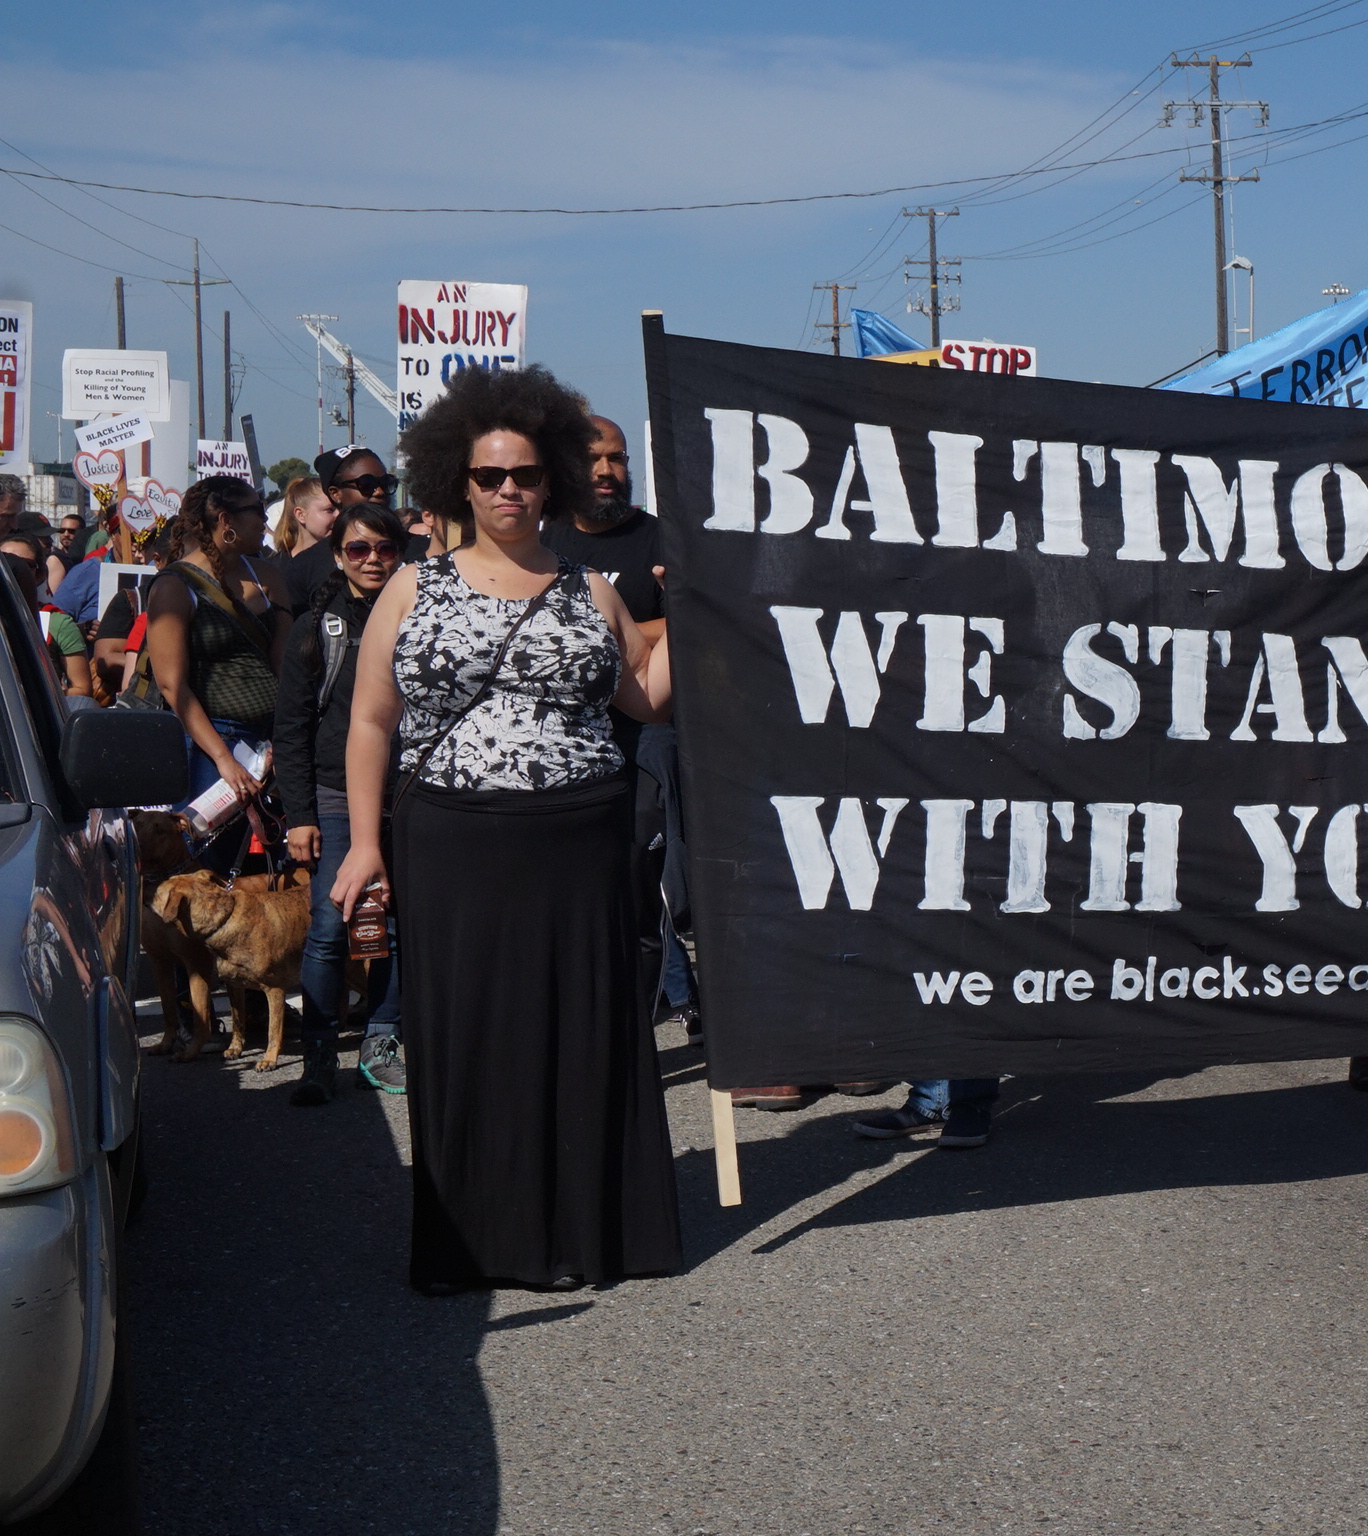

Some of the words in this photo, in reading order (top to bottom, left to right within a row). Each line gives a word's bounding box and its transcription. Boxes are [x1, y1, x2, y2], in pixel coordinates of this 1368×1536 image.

[437, 283, 467, 303] AN
[398, 303, 517, 347] INJURY
[401, 356, 430, 376] TO
[942, 343, 1031, 376] STOP
[75, 368, 94, 377] Stop
[95, 368, 119, 376] Racial
[120, 369, 155, 378] Profiling
[83, 384, 109, 393] Killing
[120, 384, 147, 394] Young
[112, 393, 145, 401] Women
[85, 425, 116, 442] BLACK
[116, 417, 141, 432] LIVES
[98, 430, 136, 448] MATTER
[215, 442, 229, 450] AN
[83, 458, 119, 479] Justice
[197, 450, 249, 470] INJURY
[147, 488, 179, 516] Equity
[127, 505, 153, 520] Love
[769, 605, 1006, 734] WE
[769, 796, 1183, 914] WITH
[913, 970, 994, 1006] we
[1012, 968, 1095, 1004] are
